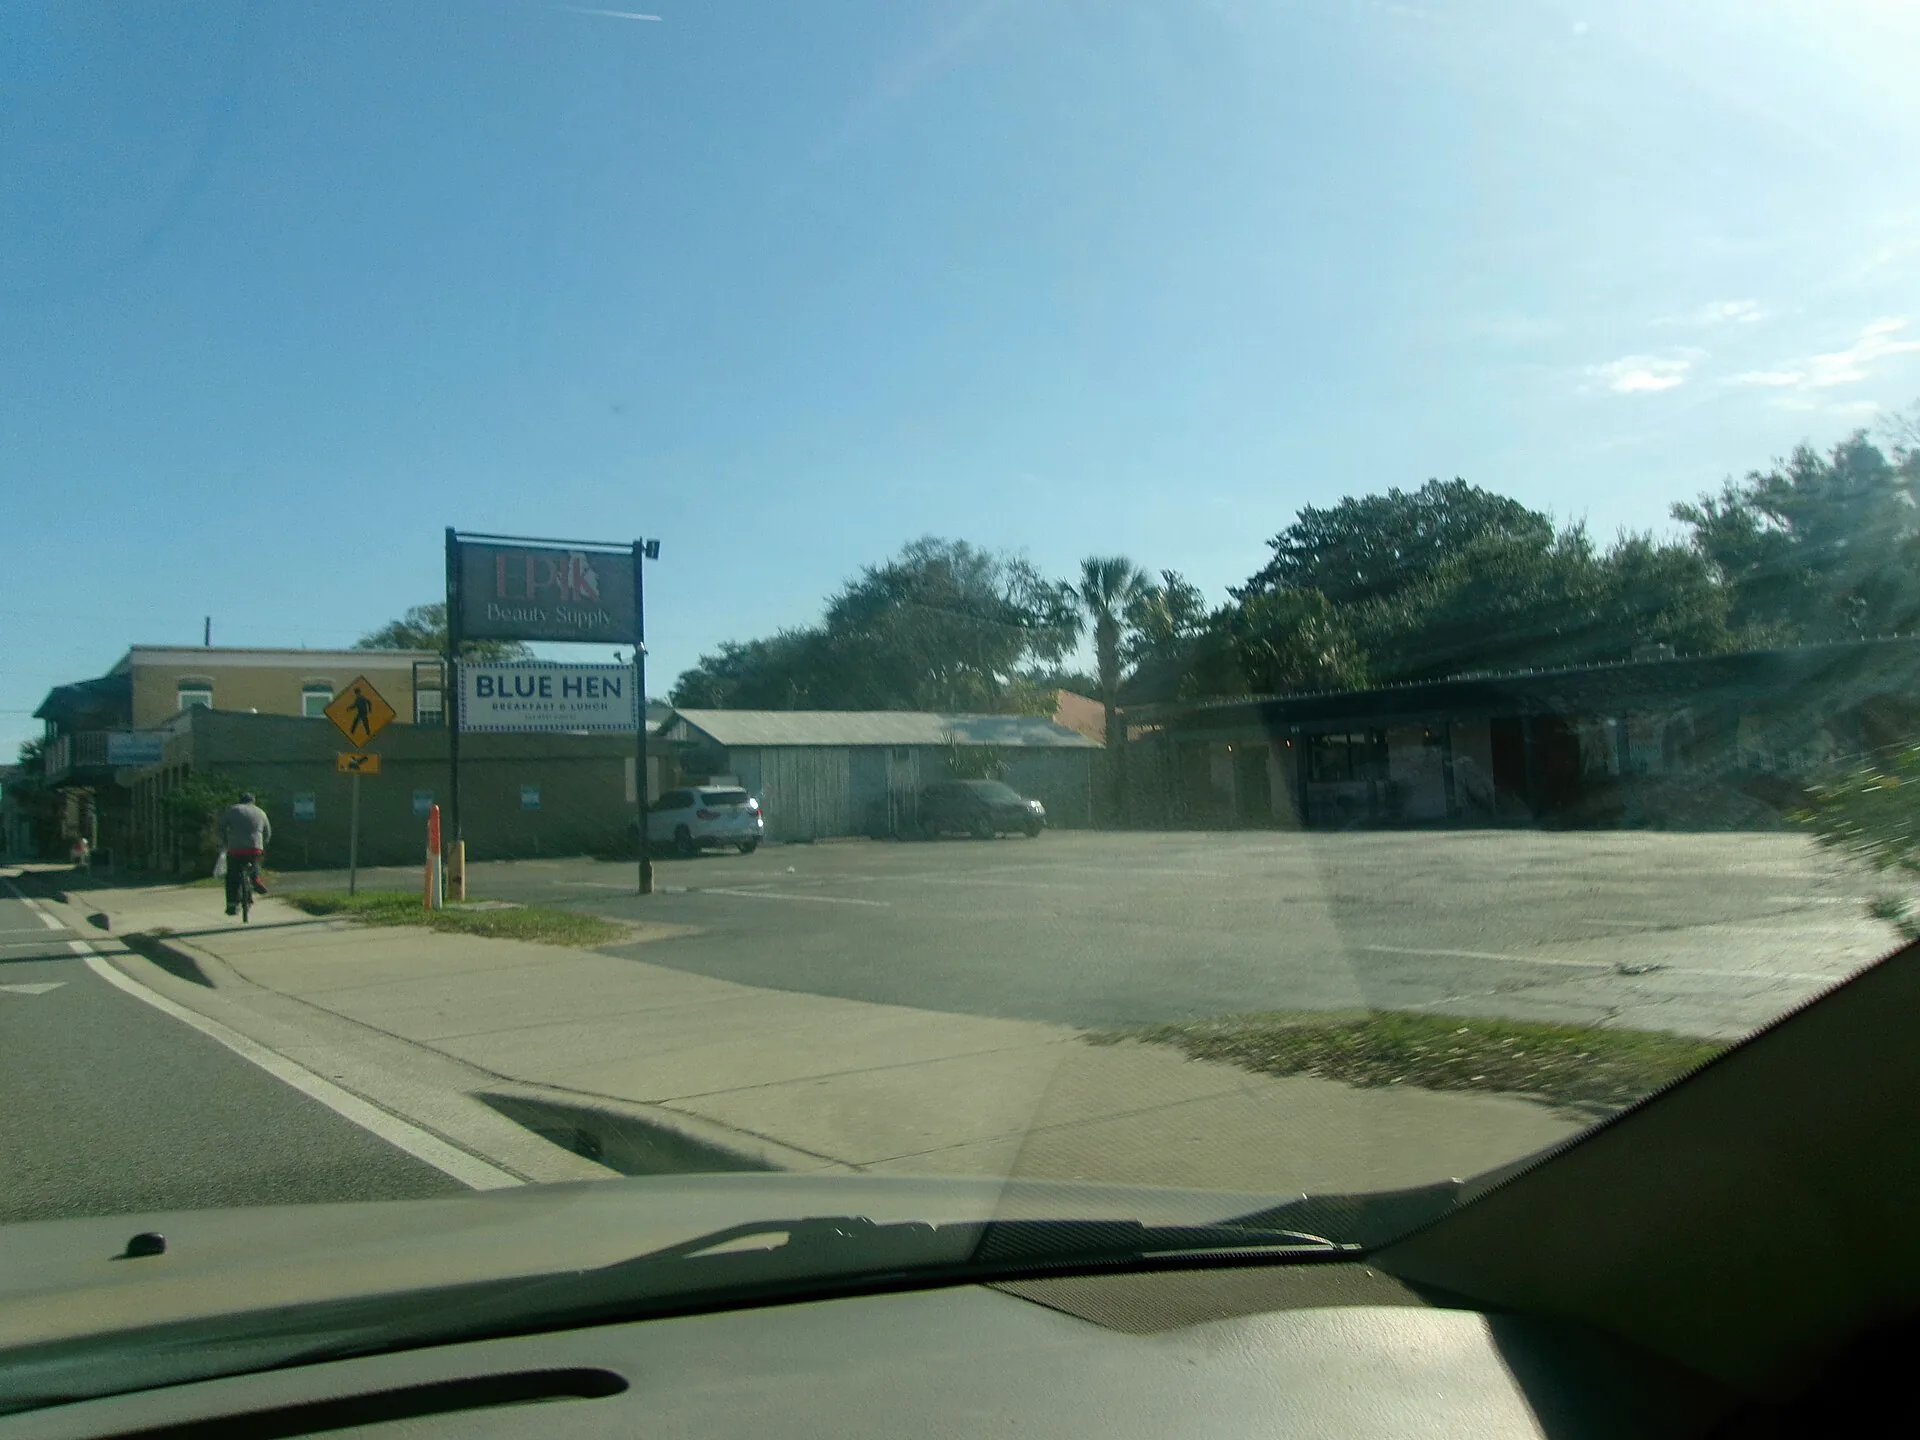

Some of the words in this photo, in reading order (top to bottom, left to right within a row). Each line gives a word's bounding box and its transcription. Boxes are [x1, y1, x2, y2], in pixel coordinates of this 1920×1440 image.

[487, 603, 550, 623] Beauty
[556, 605, 612, 631] Supply
[476, 674, 553, 699] BLUE
[562, 674, 622, 699] HEN
[492, 702, 555, 712] BREAKFAST
[571, 702, 608, 712] LUNCH
